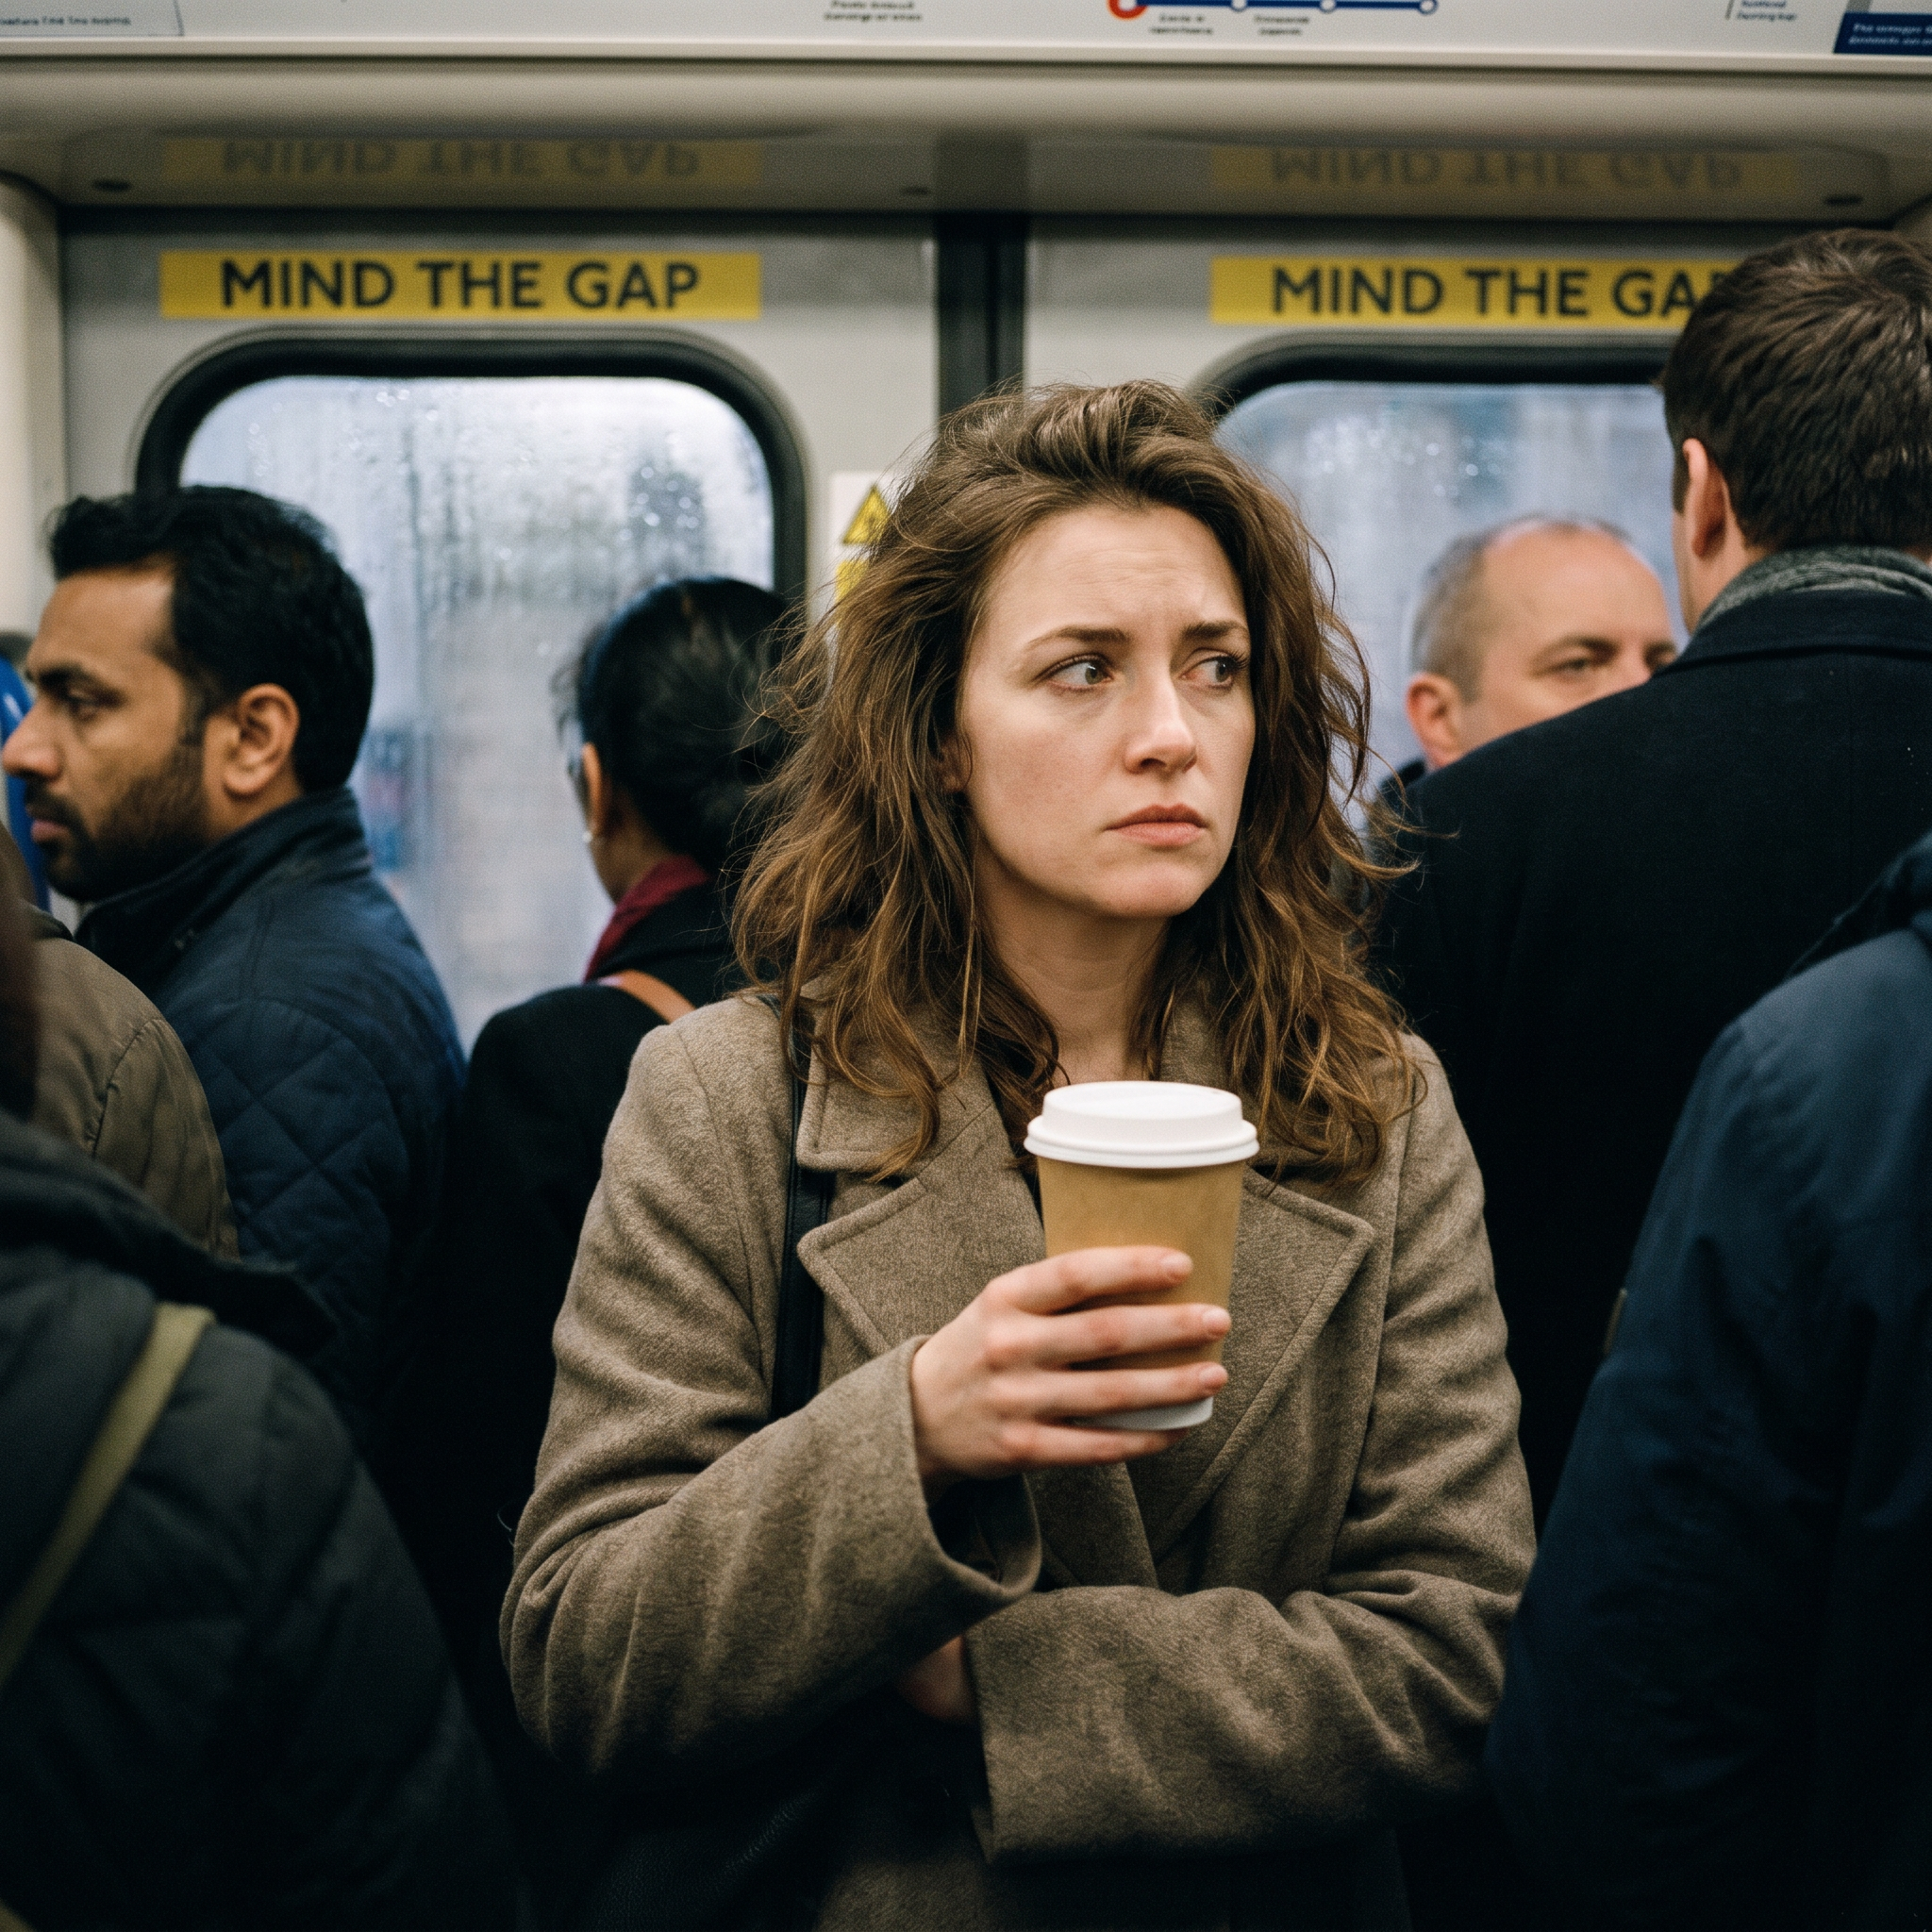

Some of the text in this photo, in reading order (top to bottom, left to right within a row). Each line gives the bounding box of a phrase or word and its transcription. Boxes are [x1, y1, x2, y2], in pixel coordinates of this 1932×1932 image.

[221, 258, 700, 310] MIND THE GAP
[1272, 266, 1730, 318] MIND THE GA
